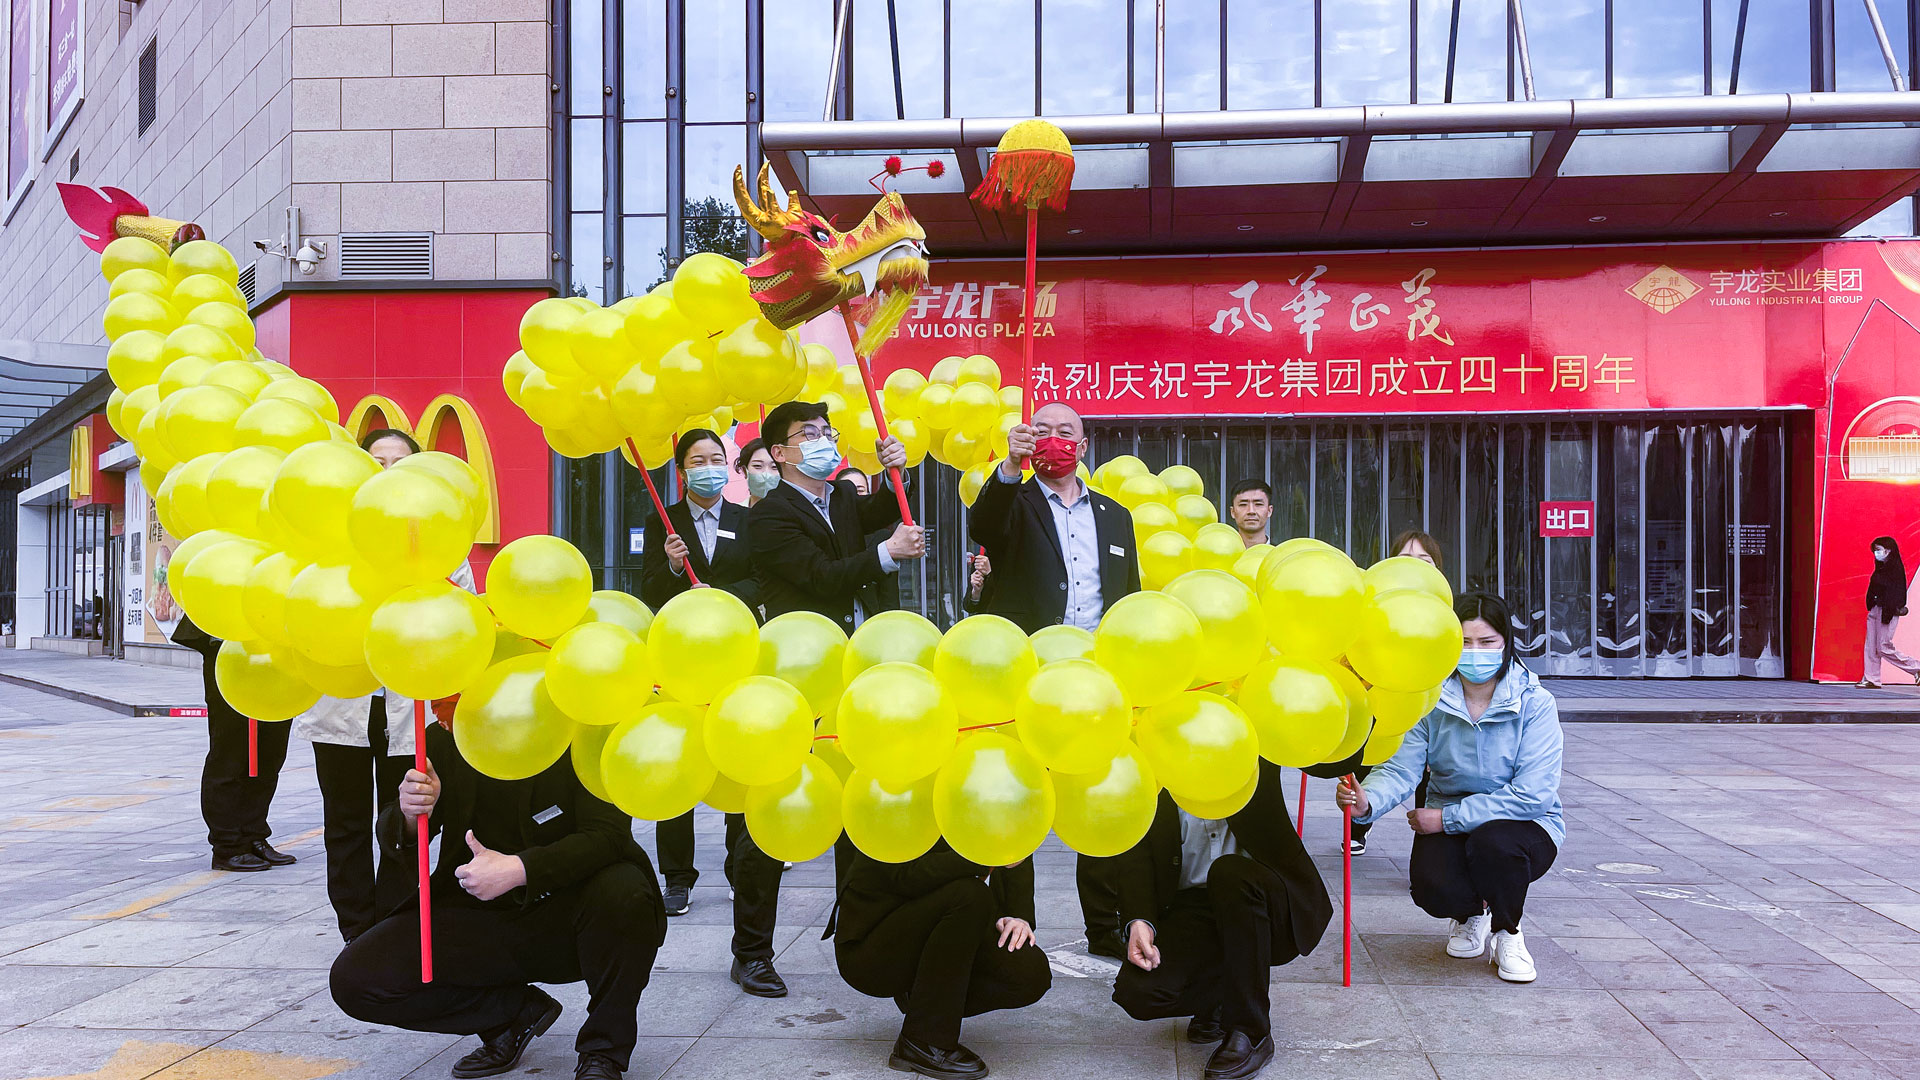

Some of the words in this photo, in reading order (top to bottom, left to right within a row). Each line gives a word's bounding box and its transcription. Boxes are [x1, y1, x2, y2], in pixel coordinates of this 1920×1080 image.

[1709, 268, 1863, 294] 宇龙实业集团
[909, 281, 1058, 318] 宇龙广场
[1709, 297, 1751, 307] YULONG
[1756, 295, 1824, 306] INDUSTRIAL
[1828, 295, 1863, 305] GROUP
[907, 323, 987, 339] YULONG
[993, 322, 1056, 338] PLAZA
[1021, 353, 1637, 401] 热烈庆祝宇龙集团成立四十周年
[1545, 508, 1590, 530] 出口
